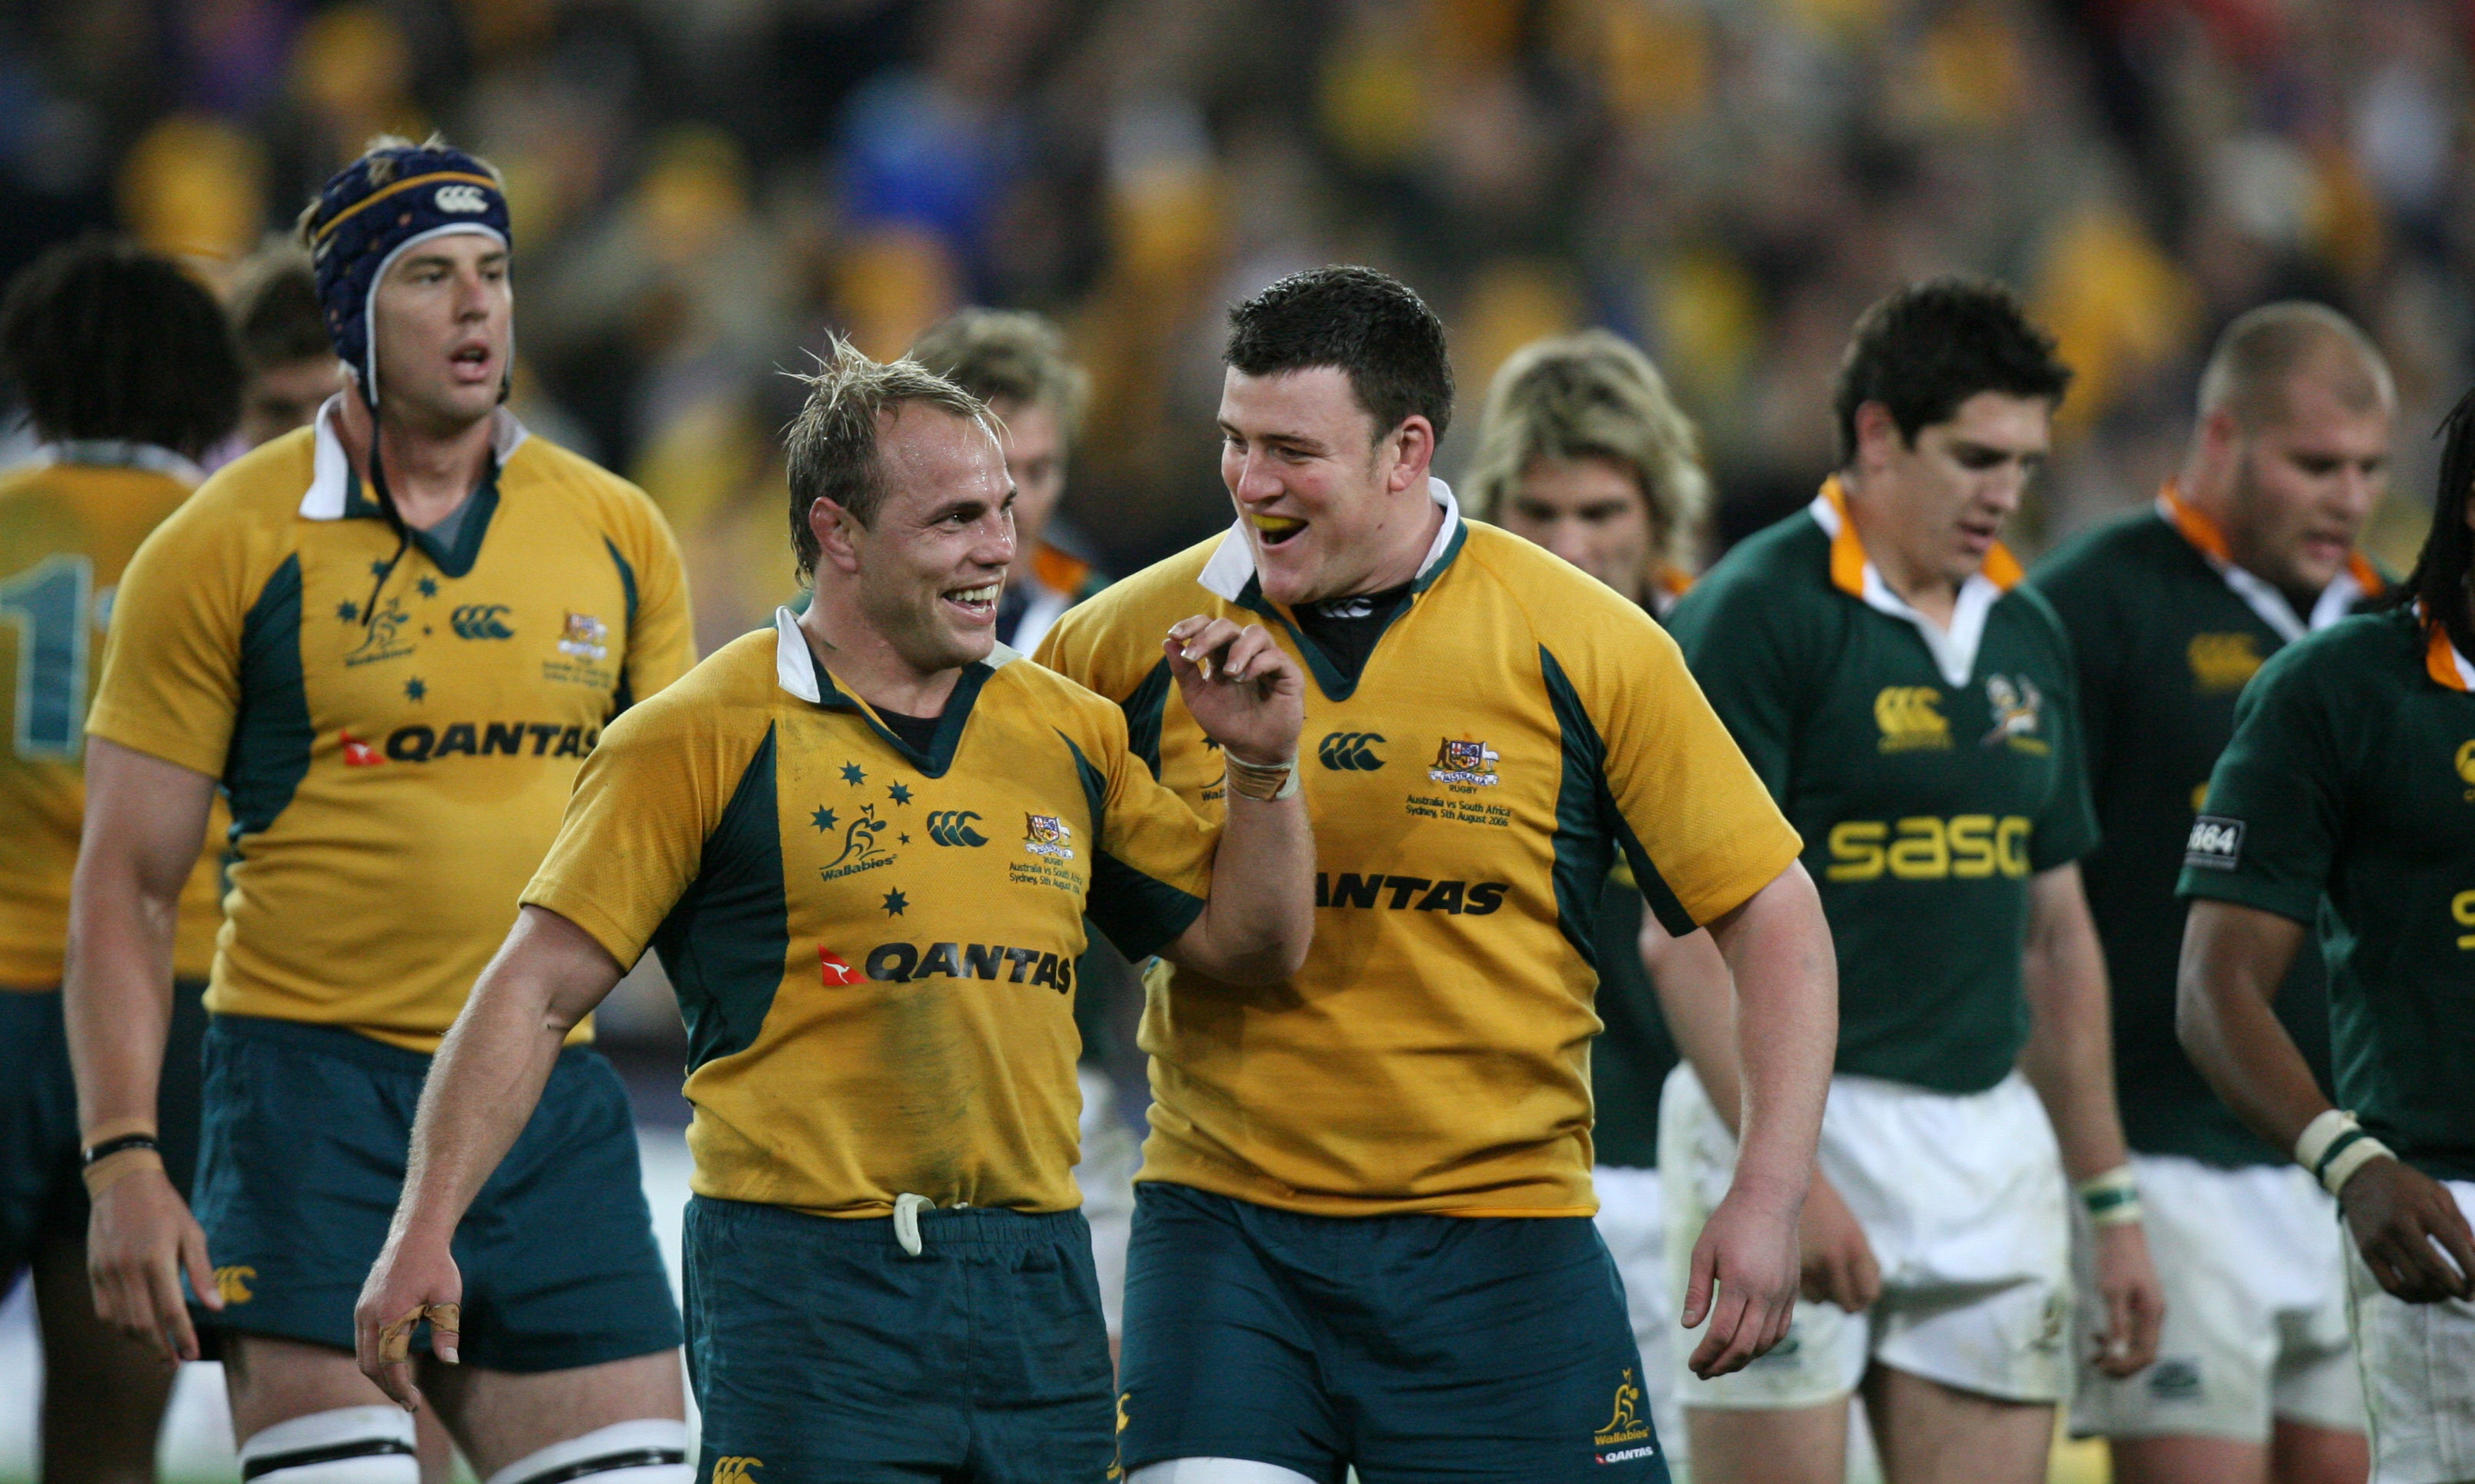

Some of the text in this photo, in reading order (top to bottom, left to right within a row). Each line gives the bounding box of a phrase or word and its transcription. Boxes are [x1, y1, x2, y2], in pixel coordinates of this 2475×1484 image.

[0, 552, 120, 763] 1
[385, 723, 598, 762] QANTAS
[1449, 784, 1477, 794] RUGBY
[1406, 805, 1508, 827] Sydney, 5th August 2006
[1407, 794, 1511, 817] Australia vs South Africa
[2187, 822, 2236, 855] 664
[821, 857, 893, 882] Wallabies
[1010, 862, 1041, 873] Australia
[1316, 872, 1510, 915] NTAS
[864, 942, 1071, 995] QANTAS
[1594, 1429, 1648, 1446] Wallabies
[1605, 1446, 1654, 1462] QANTAS
